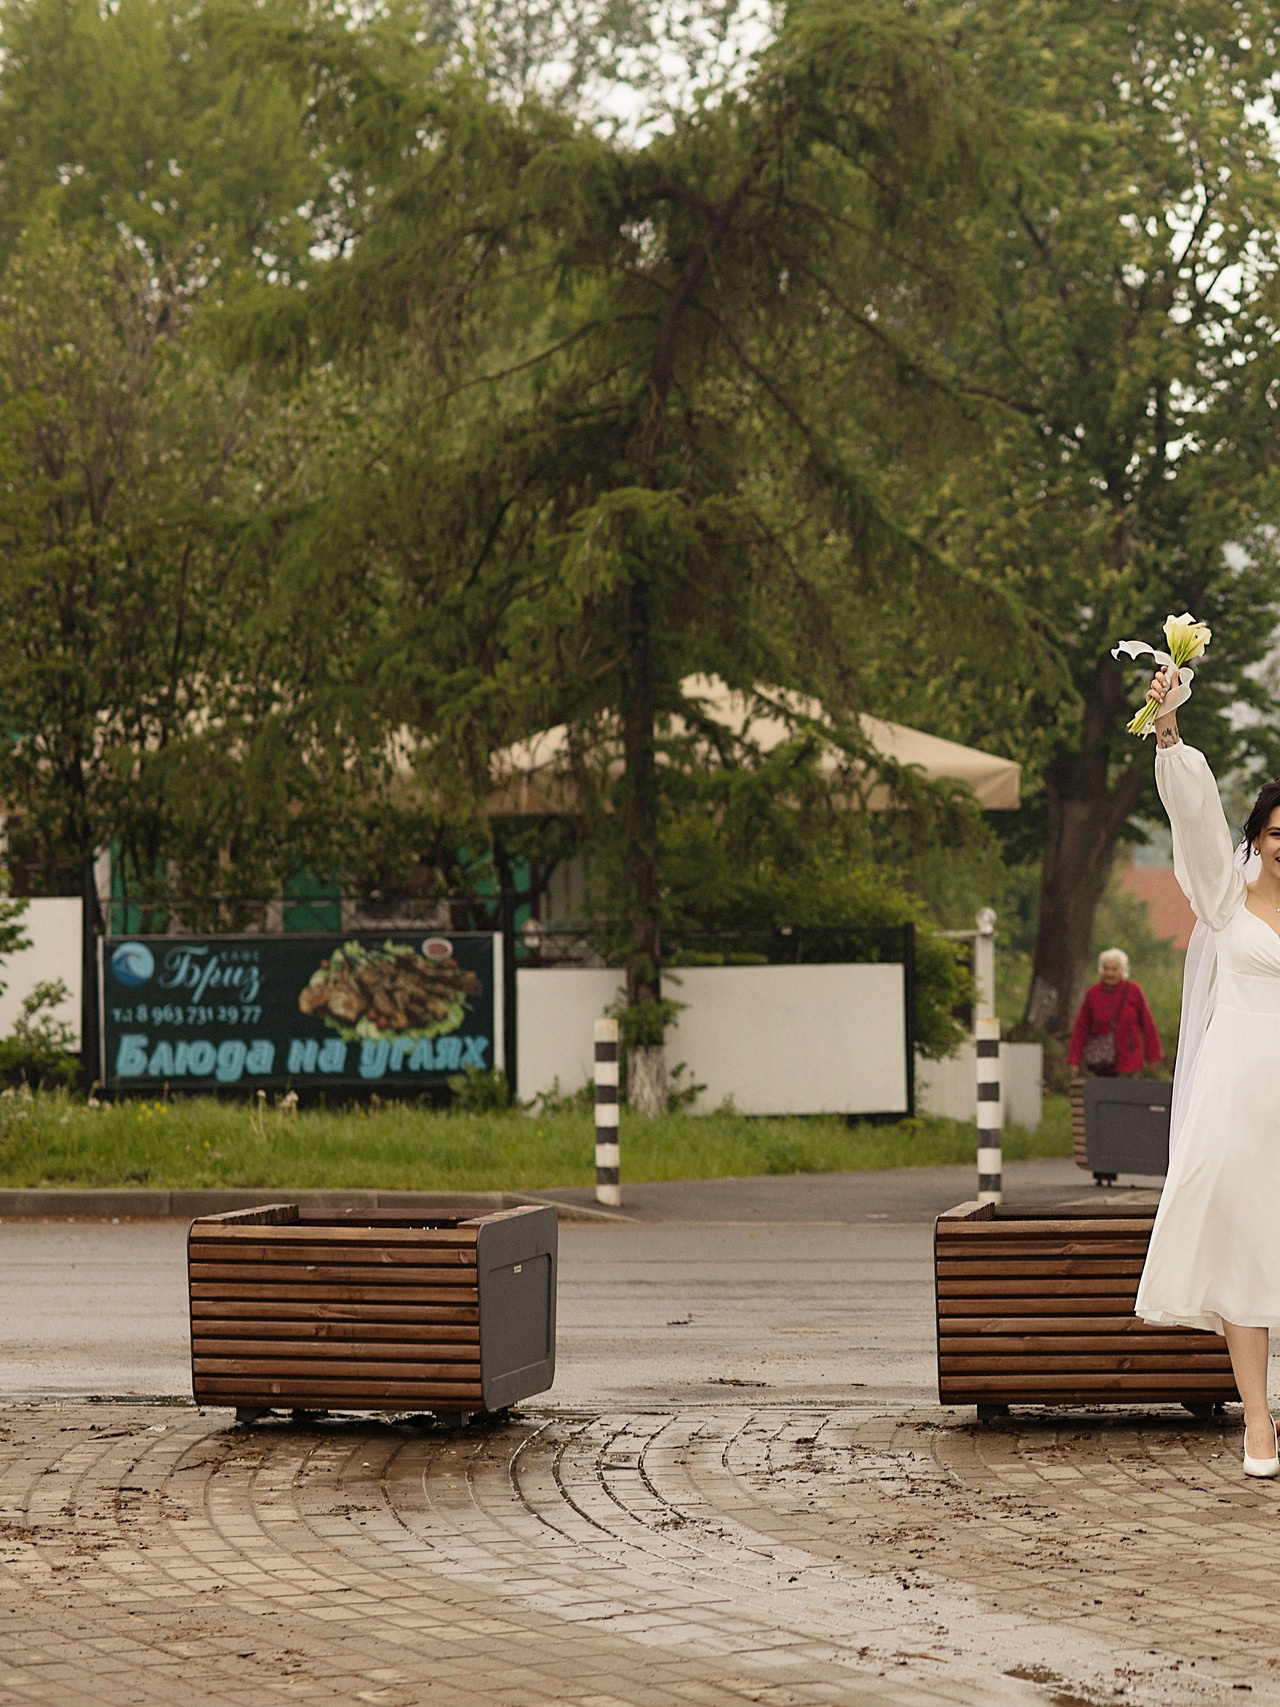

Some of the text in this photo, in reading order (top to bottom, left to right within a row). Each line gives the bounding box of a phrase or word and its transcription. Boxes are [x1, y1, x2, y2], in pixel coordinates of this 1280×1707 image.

[157, 946, 265, 1004] Бриз
[135, 1004, 149, 1023] 8
[241, 1006, 262, 1024] 77
[116, 1034, 489, 1083] Блюда на углях
